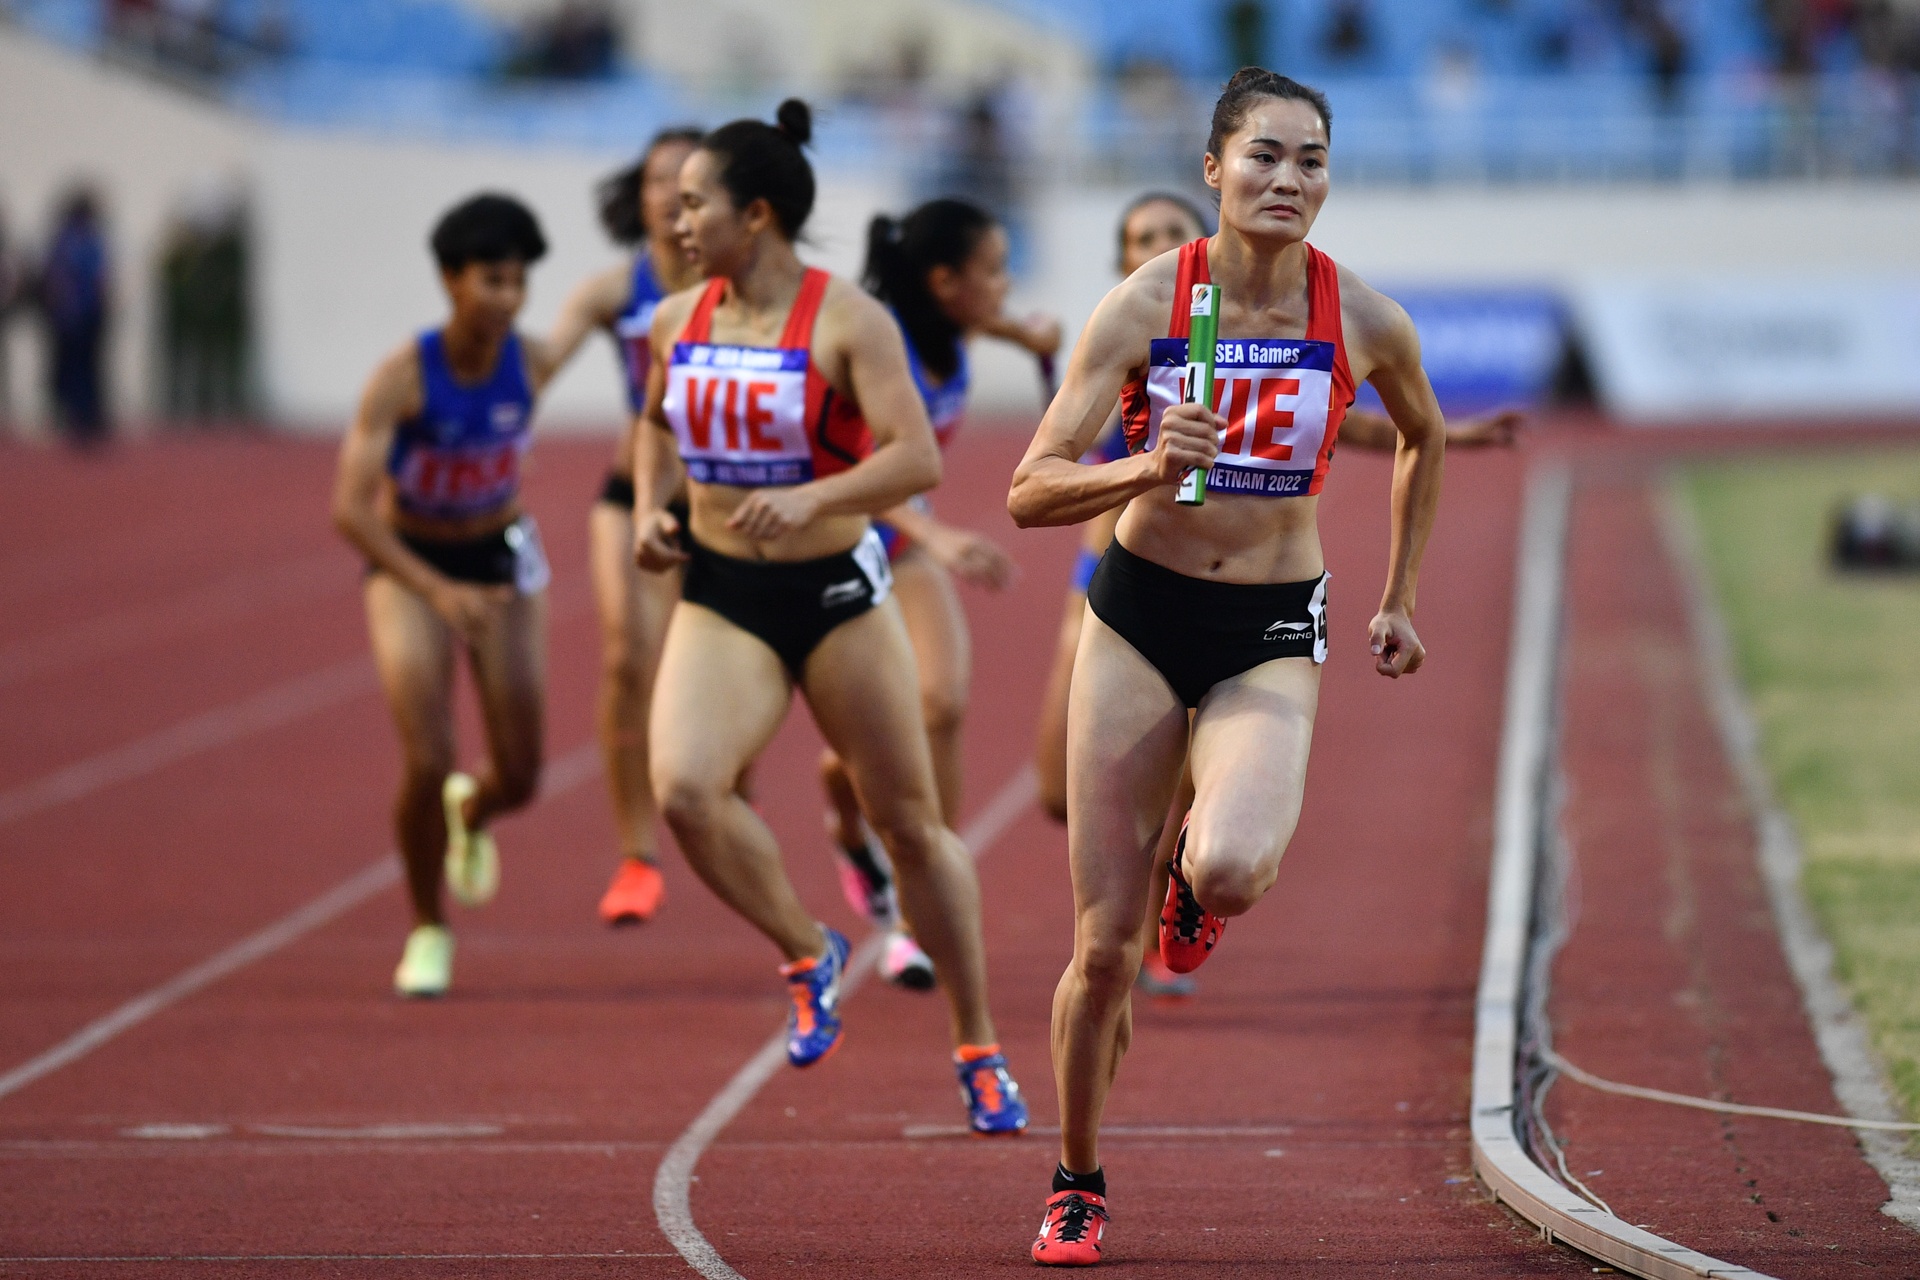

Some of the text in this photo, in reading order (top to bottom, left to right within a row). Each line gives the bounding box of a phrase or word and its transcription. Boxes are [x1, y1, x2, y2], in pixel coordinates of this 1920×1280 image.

[1215, 343, 1300, 364] SEA Games
[686, 377, 782, 450] VIE
[1267, 474, 1302, 492] 2022
[1263, 631, 1313, 641] LI-NING
